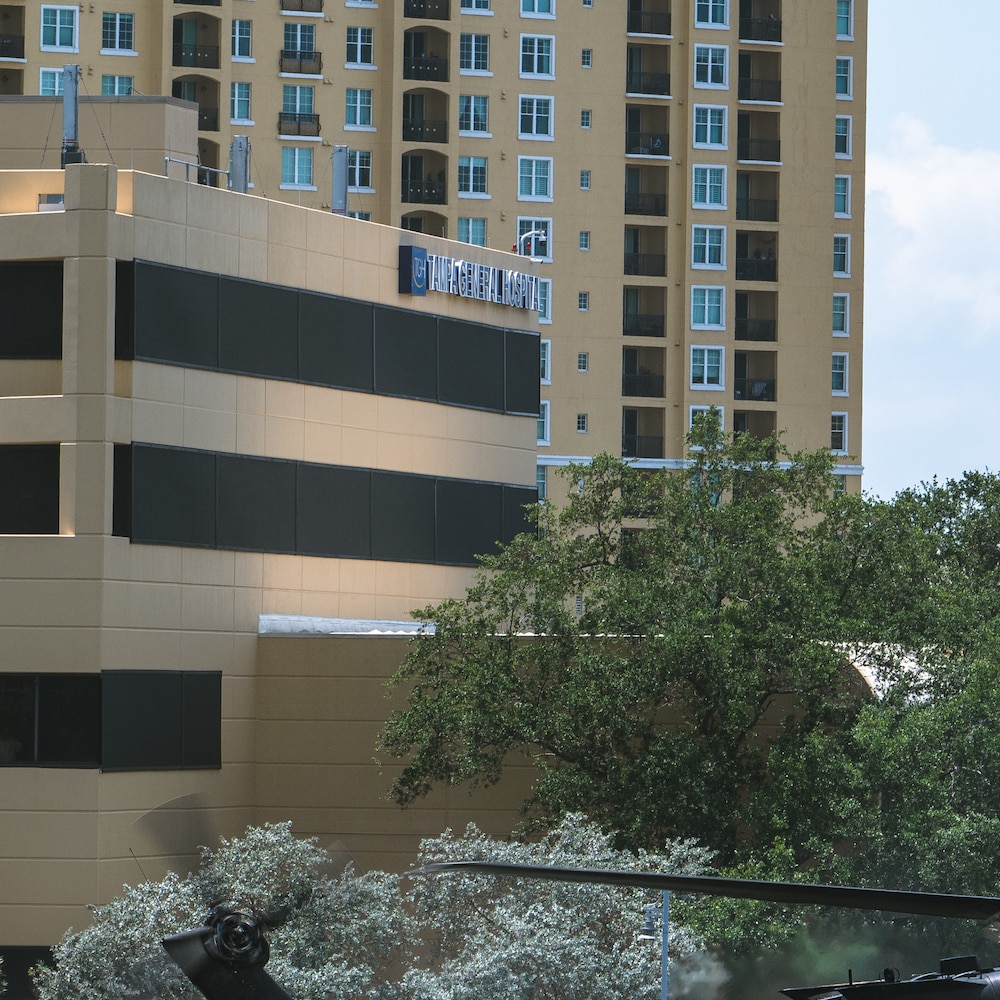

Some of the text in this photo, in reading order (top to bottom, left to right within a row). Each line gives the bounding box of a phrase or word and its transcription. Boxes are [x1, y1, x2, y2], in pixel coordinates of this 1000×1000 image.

[427, 253, 544, 312] TAMPA GENERAL HOSPITAL
